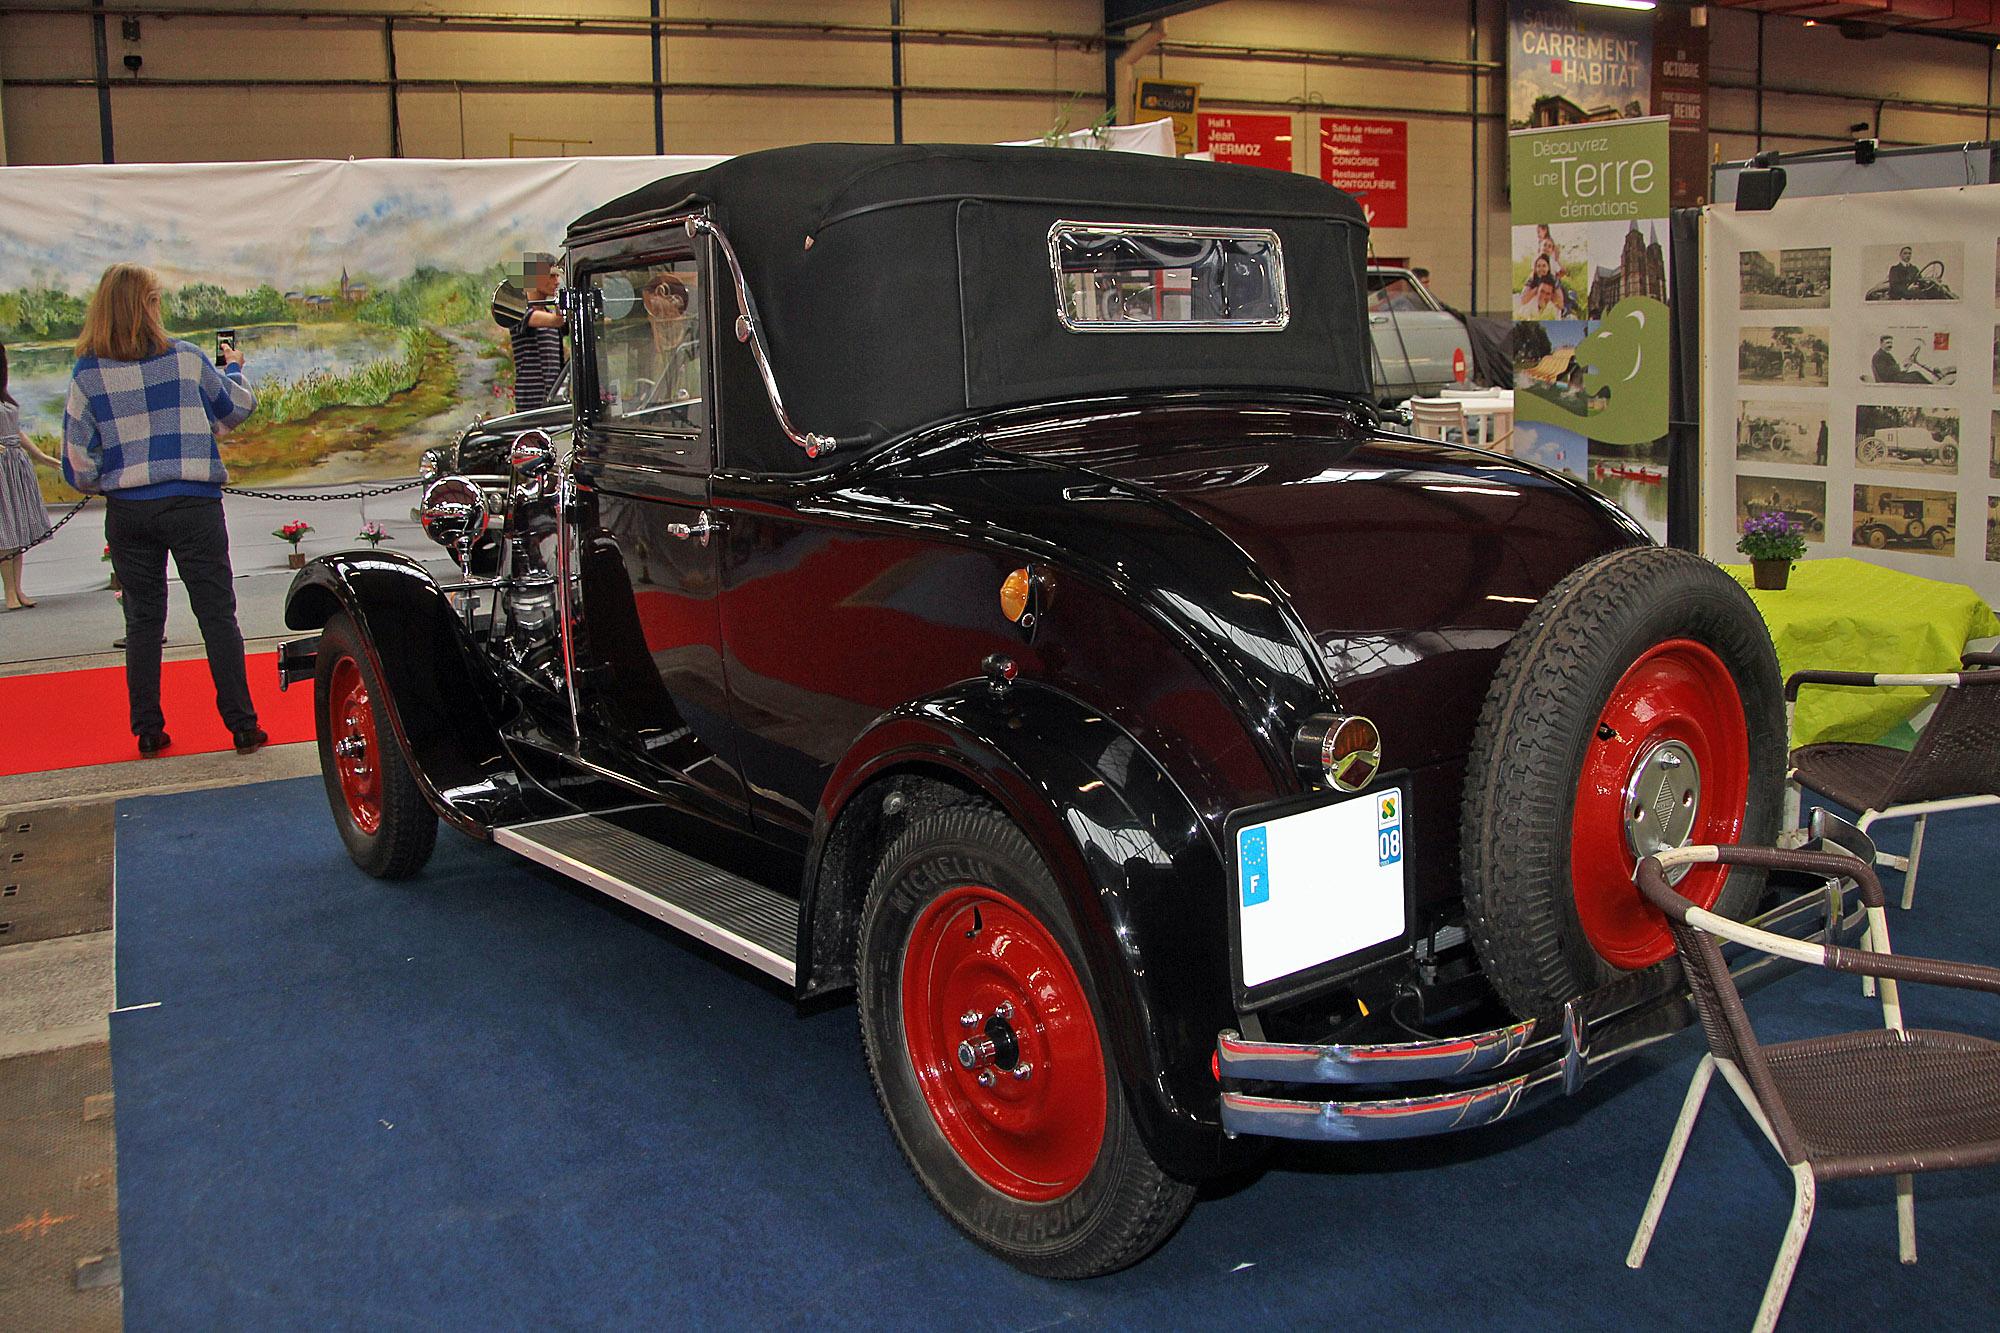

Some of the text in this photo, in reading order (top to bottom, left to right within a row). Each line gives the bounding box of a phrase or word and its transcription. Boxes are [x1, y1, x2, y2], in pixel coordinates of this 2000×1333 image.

[1522, 7, 1576, 32] SALON
[1564, 59, 1639, 88] HABITAT
[1674, 103, 1701, 120] REIMS
[1208, 118, 1231, 129] Hall 1
[1332, 122, 1394, 135] Salle de réunion
[1208, 129, 1235, 142] Jean
[1332, 133, 1363, 144] ARIANE
[1208, 144, 1262, 157] MERMOZ
[1533, 138, 1608, 158] Découvrez
[1332, 157, 1380, 167] CONCORDE
[1332, 169, 1375, 179] Restaurant
[1533, 157, 1655, 198] une Terre
[1560, 200, 1638, 218] d'émotions
[1379, 829, 1400, 860] 08
[889, 855, 996, 914] MICHELIN
[1250, 874, 1260, 894] F
